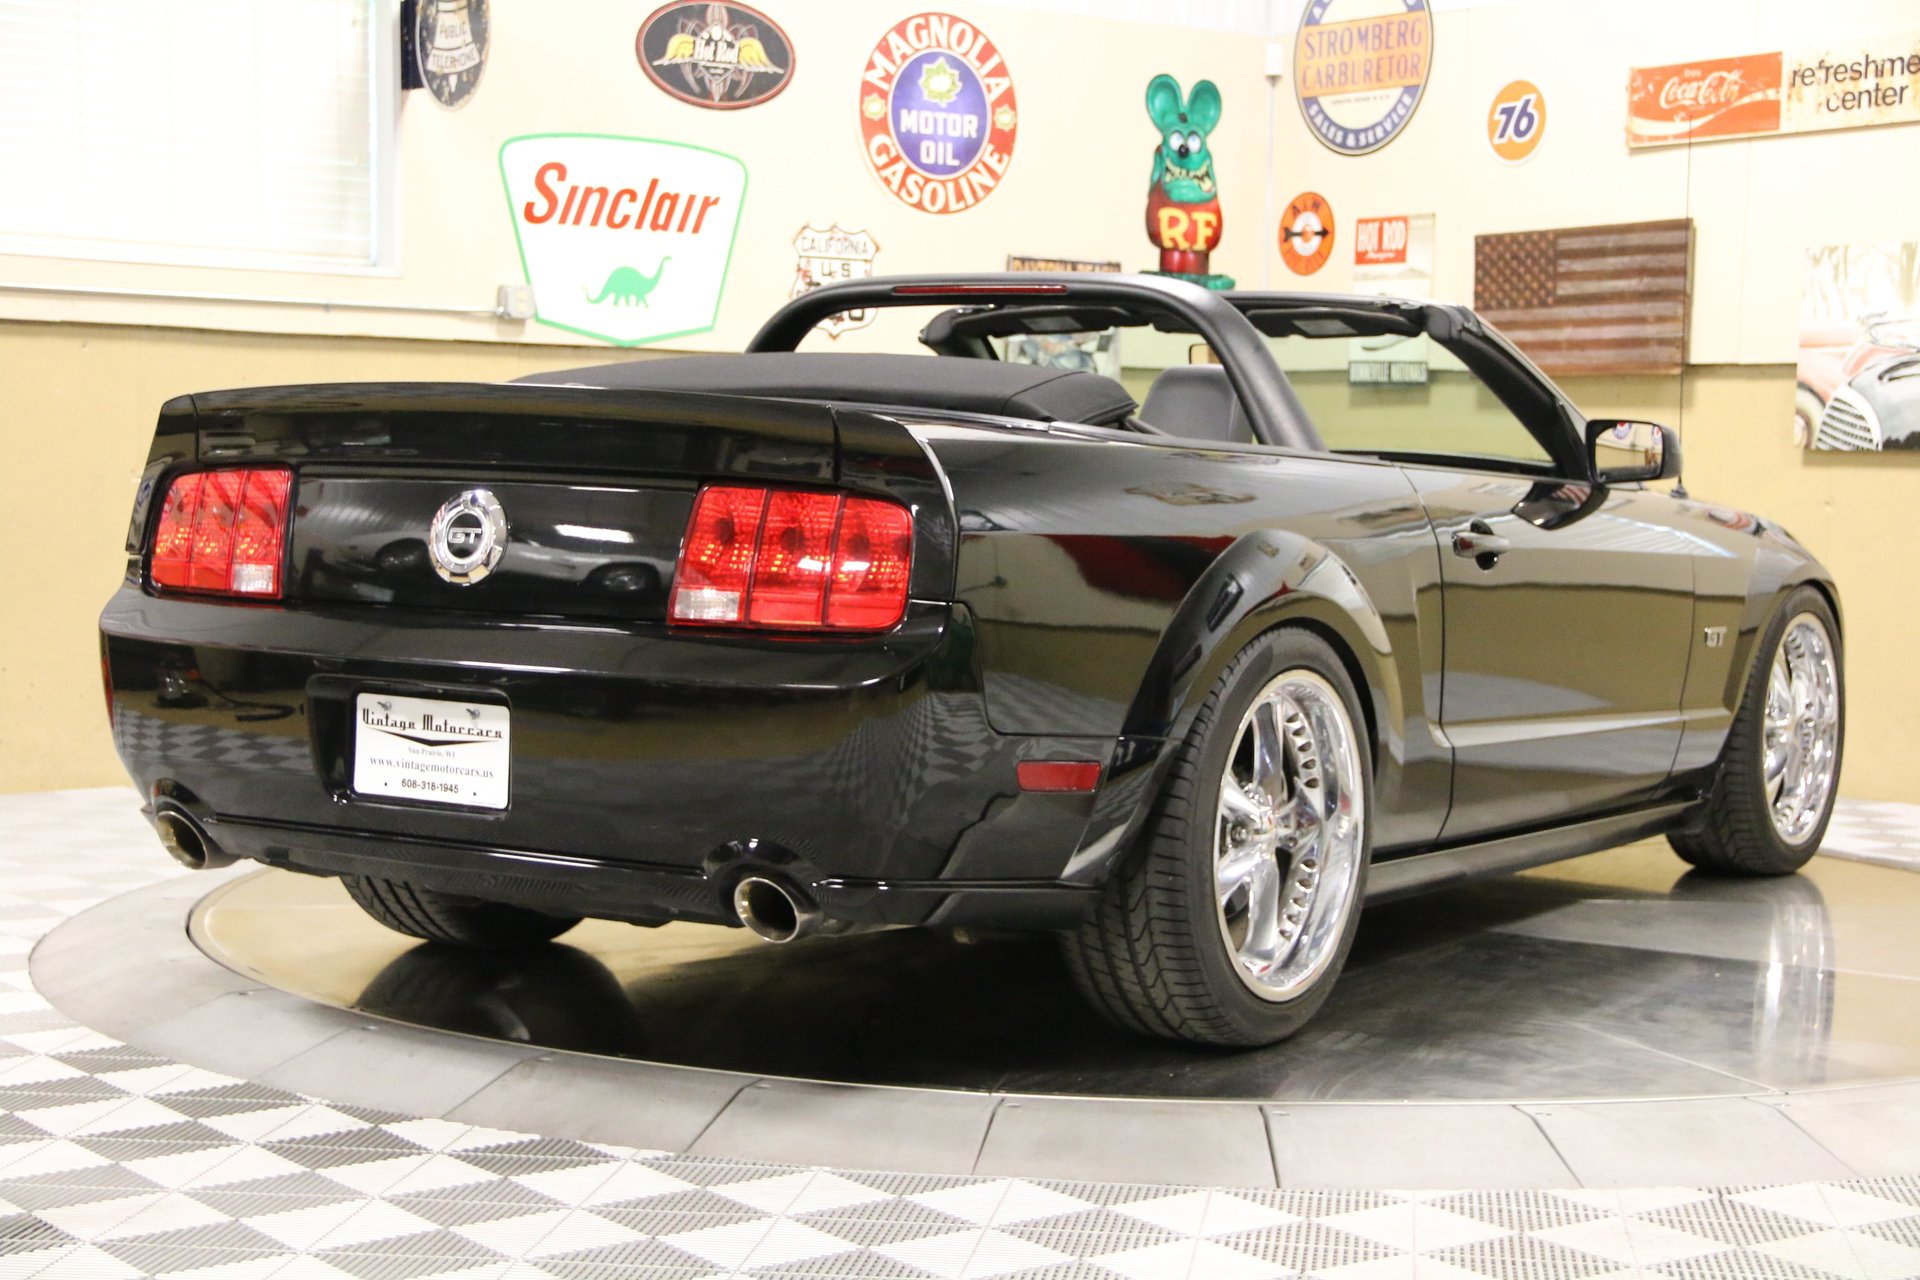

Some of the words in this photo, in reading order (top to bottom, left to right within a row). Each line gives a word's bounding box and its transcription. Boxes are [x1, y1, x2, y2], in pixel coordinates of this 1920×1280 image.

[1304, 17, 1423, 61] STROMBERG
[864, 15, 1011, 104] MAGNOLIA
[1302, 52, 1421, 91] CARBURETOR
[1826, 82, 1908, 112] center
[900, 108, 979, 139] MOTOR
[1307, 103, 1344, 144] SALES
[1497, 97, 1535, 140] 76
[919, 139, 961, 167] OIL
[868, 133, 1009, 214] GASOLINE
[522, 161, 721, 235] Sinclair
[801, 235, 868, 255] CALIFORNIA
[1157, 206, 1218, 252] RF
[447, 527, 482, 544] GT
[370, 757, 494, 779] www.vintagemotorcars.us
[401, 778, 459, 794] 608-318-1945
